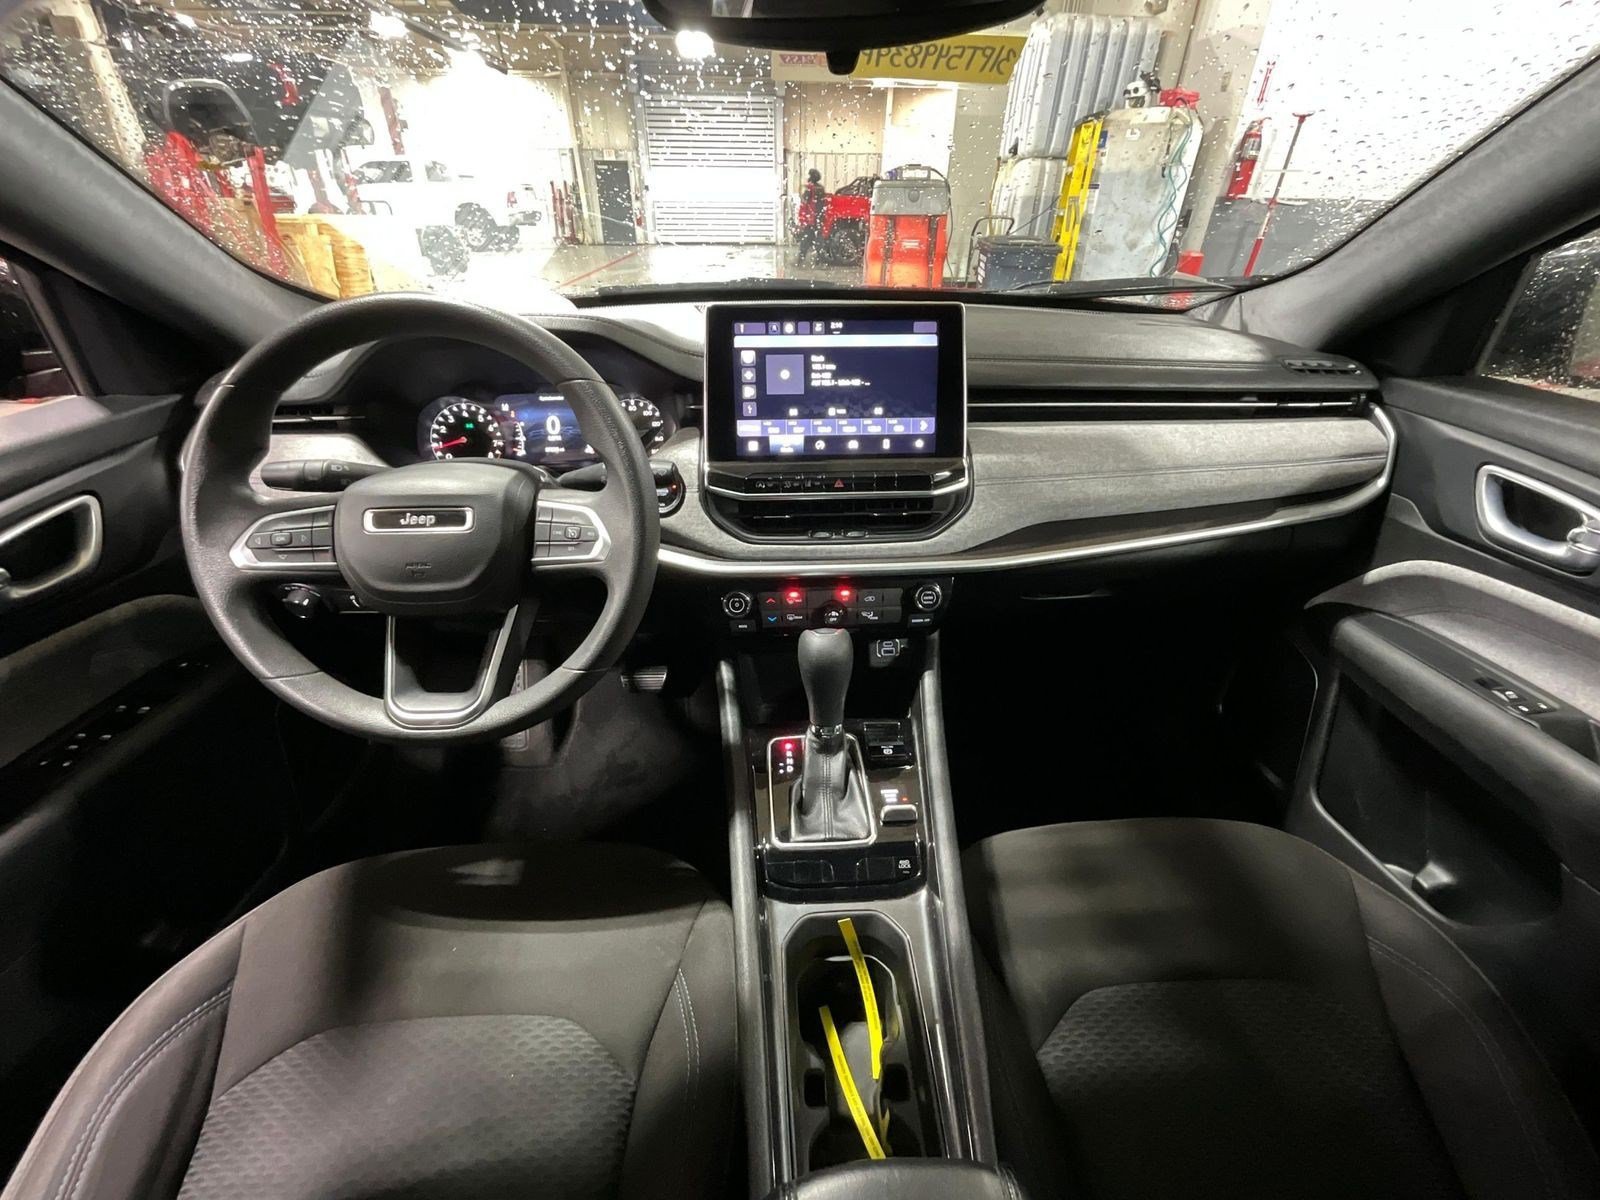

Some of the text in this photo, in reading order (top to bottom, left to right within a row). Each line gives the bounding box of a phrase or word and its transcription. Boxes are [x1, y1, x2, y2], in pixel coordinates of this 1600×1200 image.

[440, 425, 447, 433] 2
[546, 415, 560, 435] 0
[400, 512, 436, 527] Jeep
